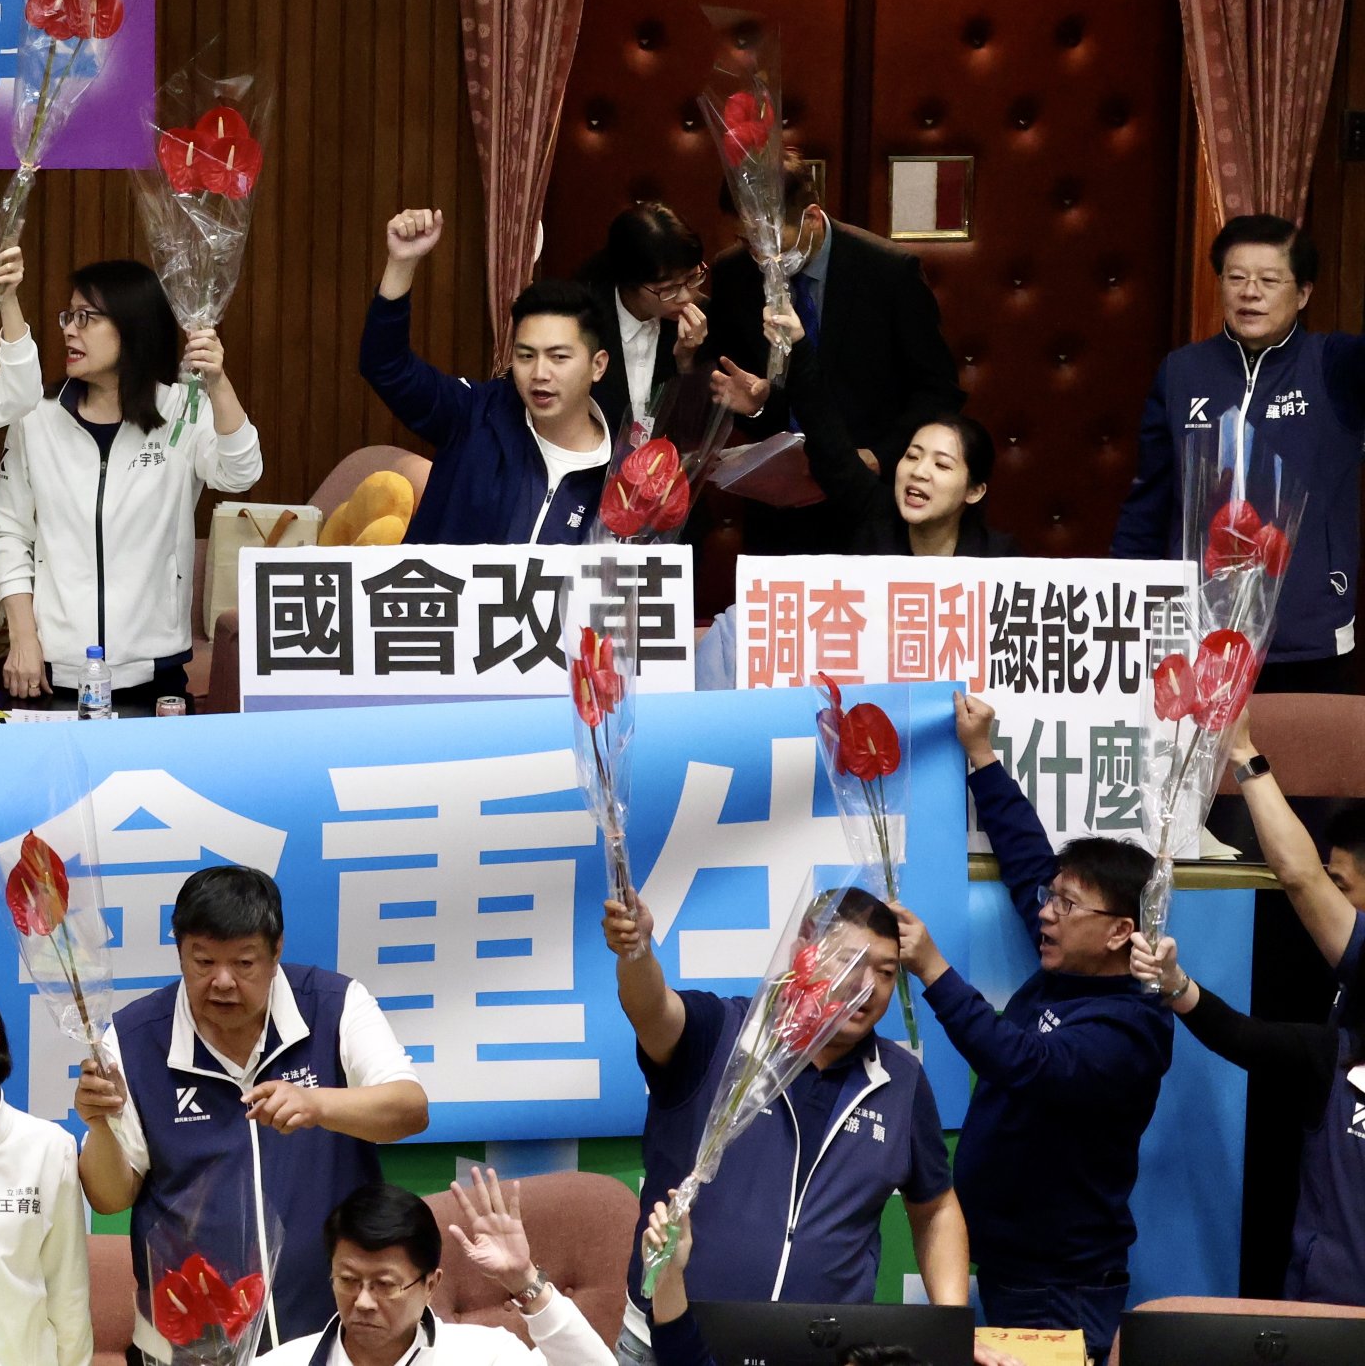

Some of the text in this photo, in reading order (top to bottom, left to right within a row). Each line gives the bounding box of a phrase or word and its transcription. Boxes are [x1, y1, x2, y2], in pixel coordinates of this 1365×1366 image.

[255, 556, 687, 677] 國會改革
[746, 579, 1190, 695] 調查 圖利綠能光電
[281, 1064, 311, 1081] 立法委
[853, 1106, 883, 1123] 立法委員
[6, 1187, 40, 1196] 立法委員
